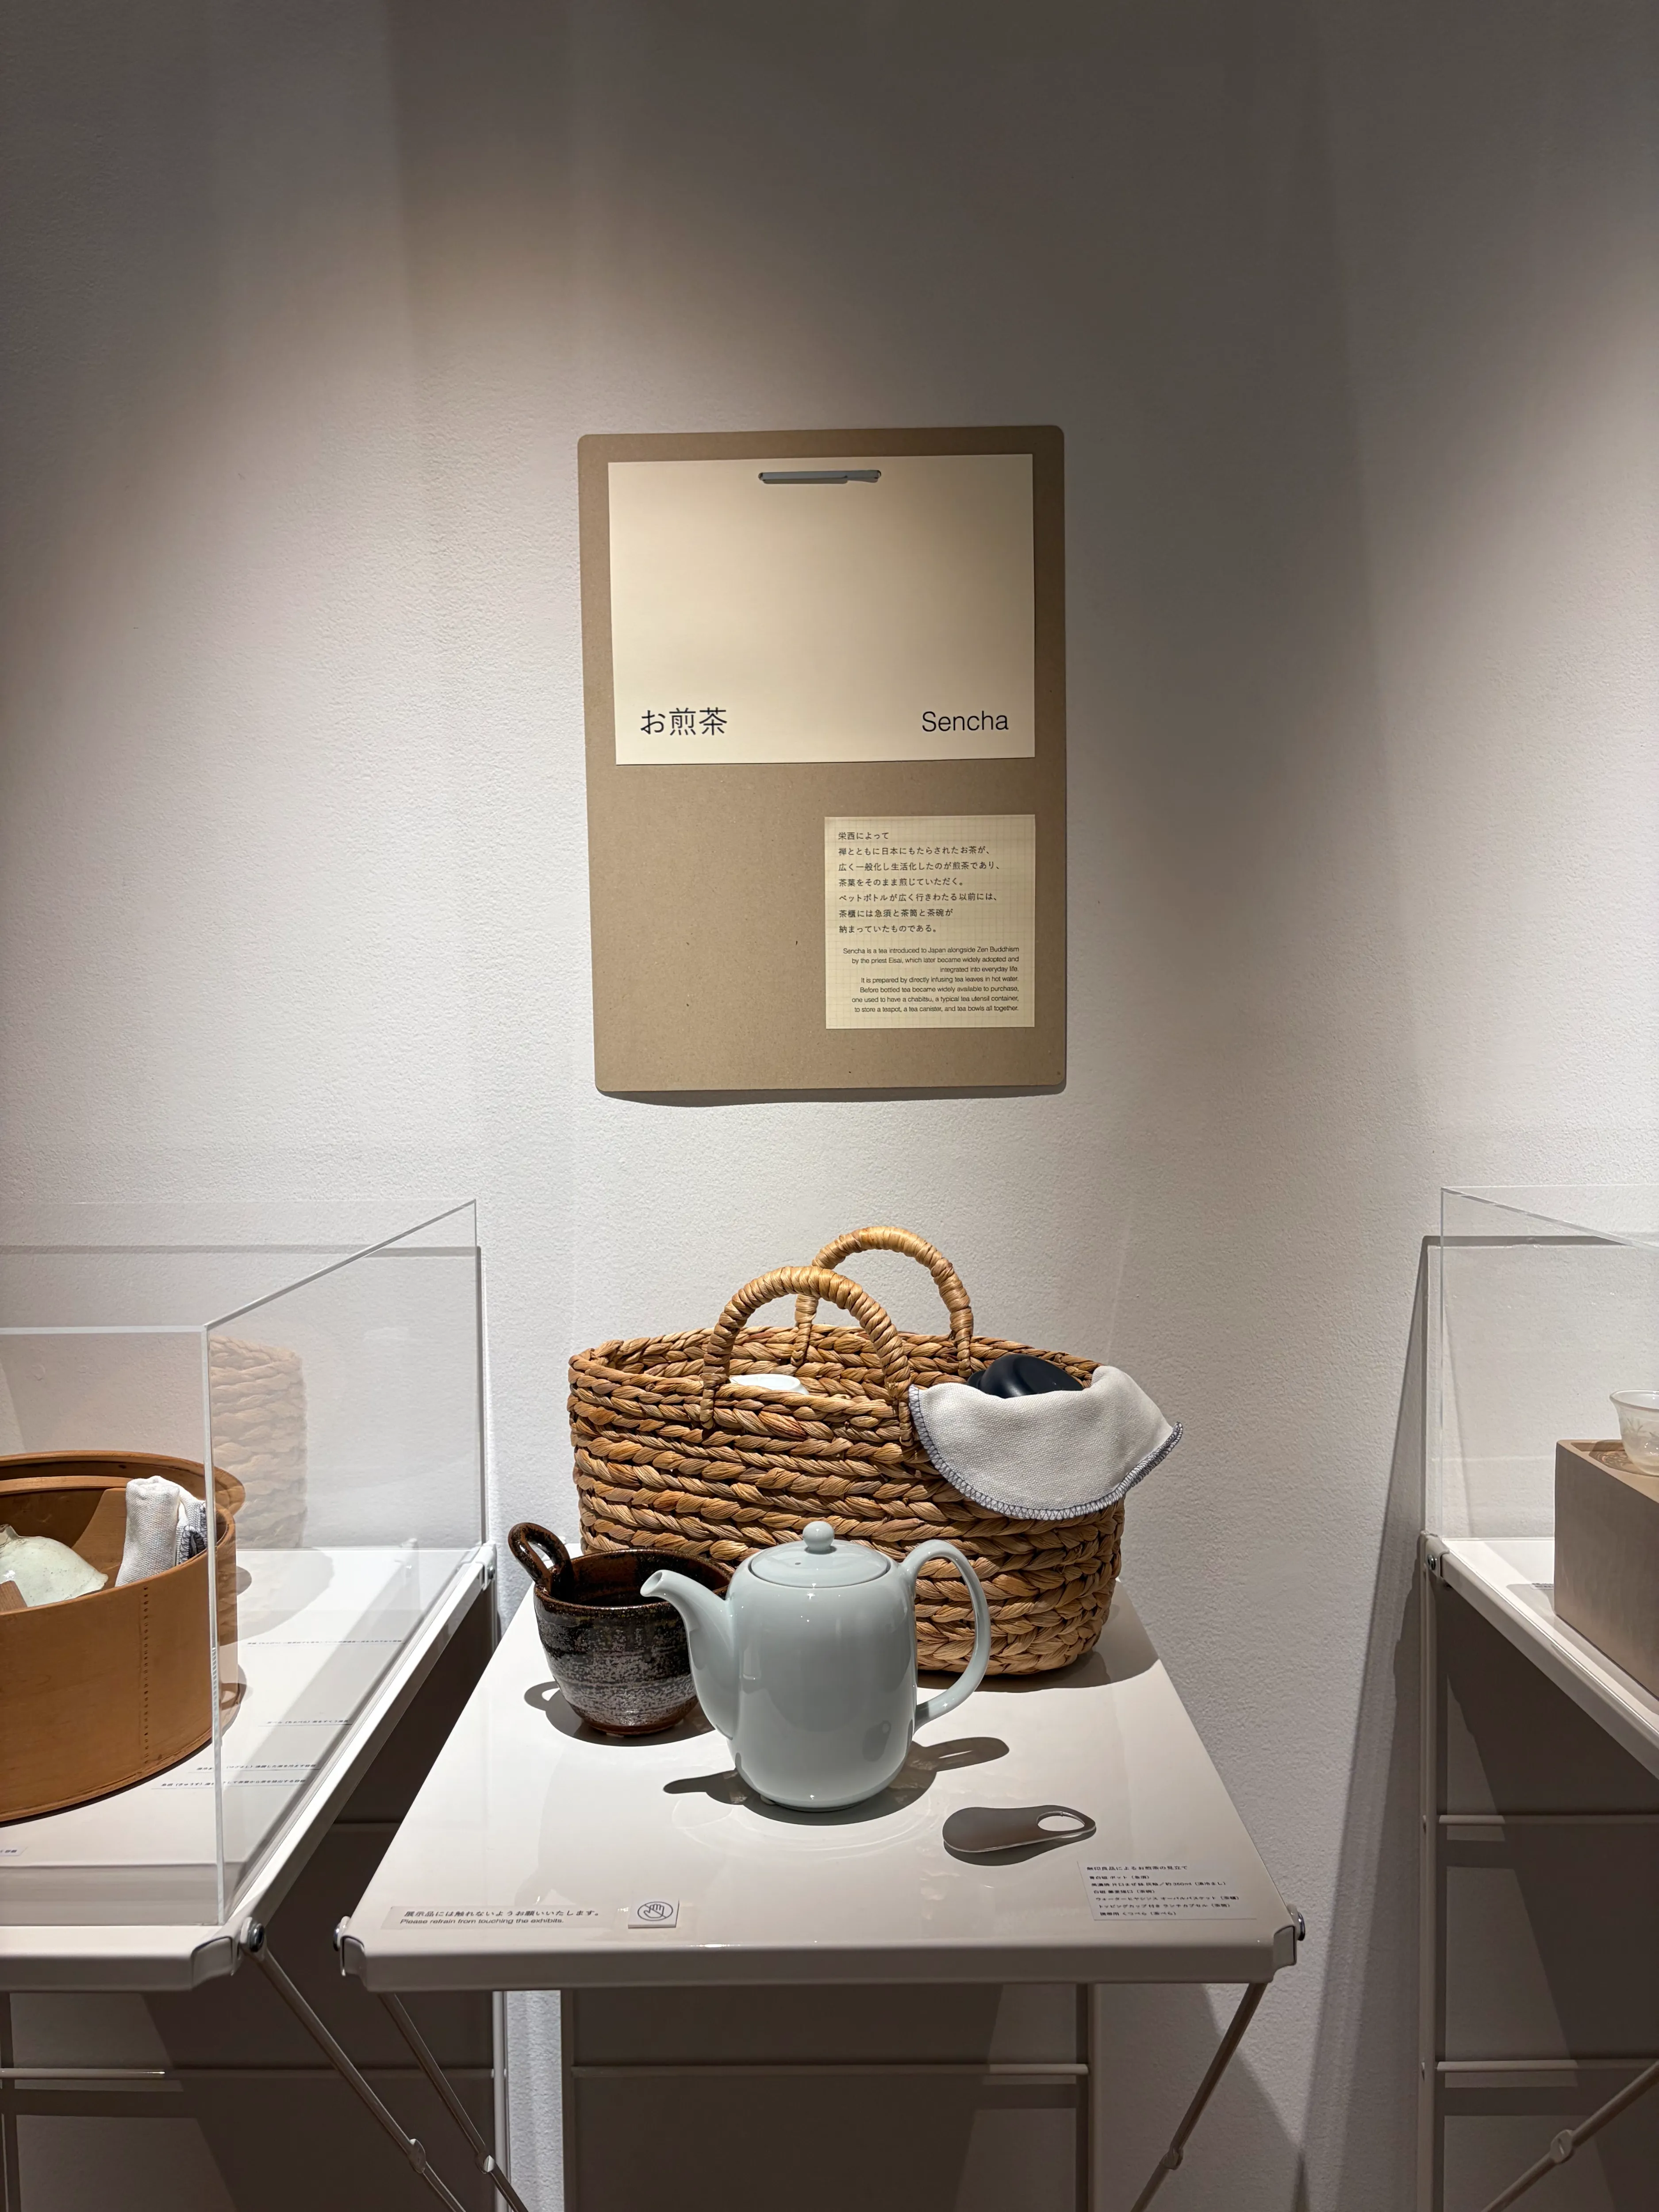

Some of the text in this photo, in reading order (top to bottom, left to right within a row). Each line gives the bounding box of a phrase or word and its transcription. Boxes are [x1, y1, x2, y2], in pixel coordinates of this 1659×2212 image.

[640, 708, 727, 736] お煎茶
[922, 711, 1009, 732] Sencha
[838, 846, 990, 856] 禅とともに日本にもたらされたお茶が、
[838, 861, 1000, 871] 広く一般化し生活化したのが煎茶であり、
[839, 878, 963, 887] 茶葉をそのまま煎じていただく。
[839, 893, 997, 902] ペットボトルが広く行きわたる以前には、
[839, 909, 953, 918] 茶櫃には急須と茶筒と茶碗が
